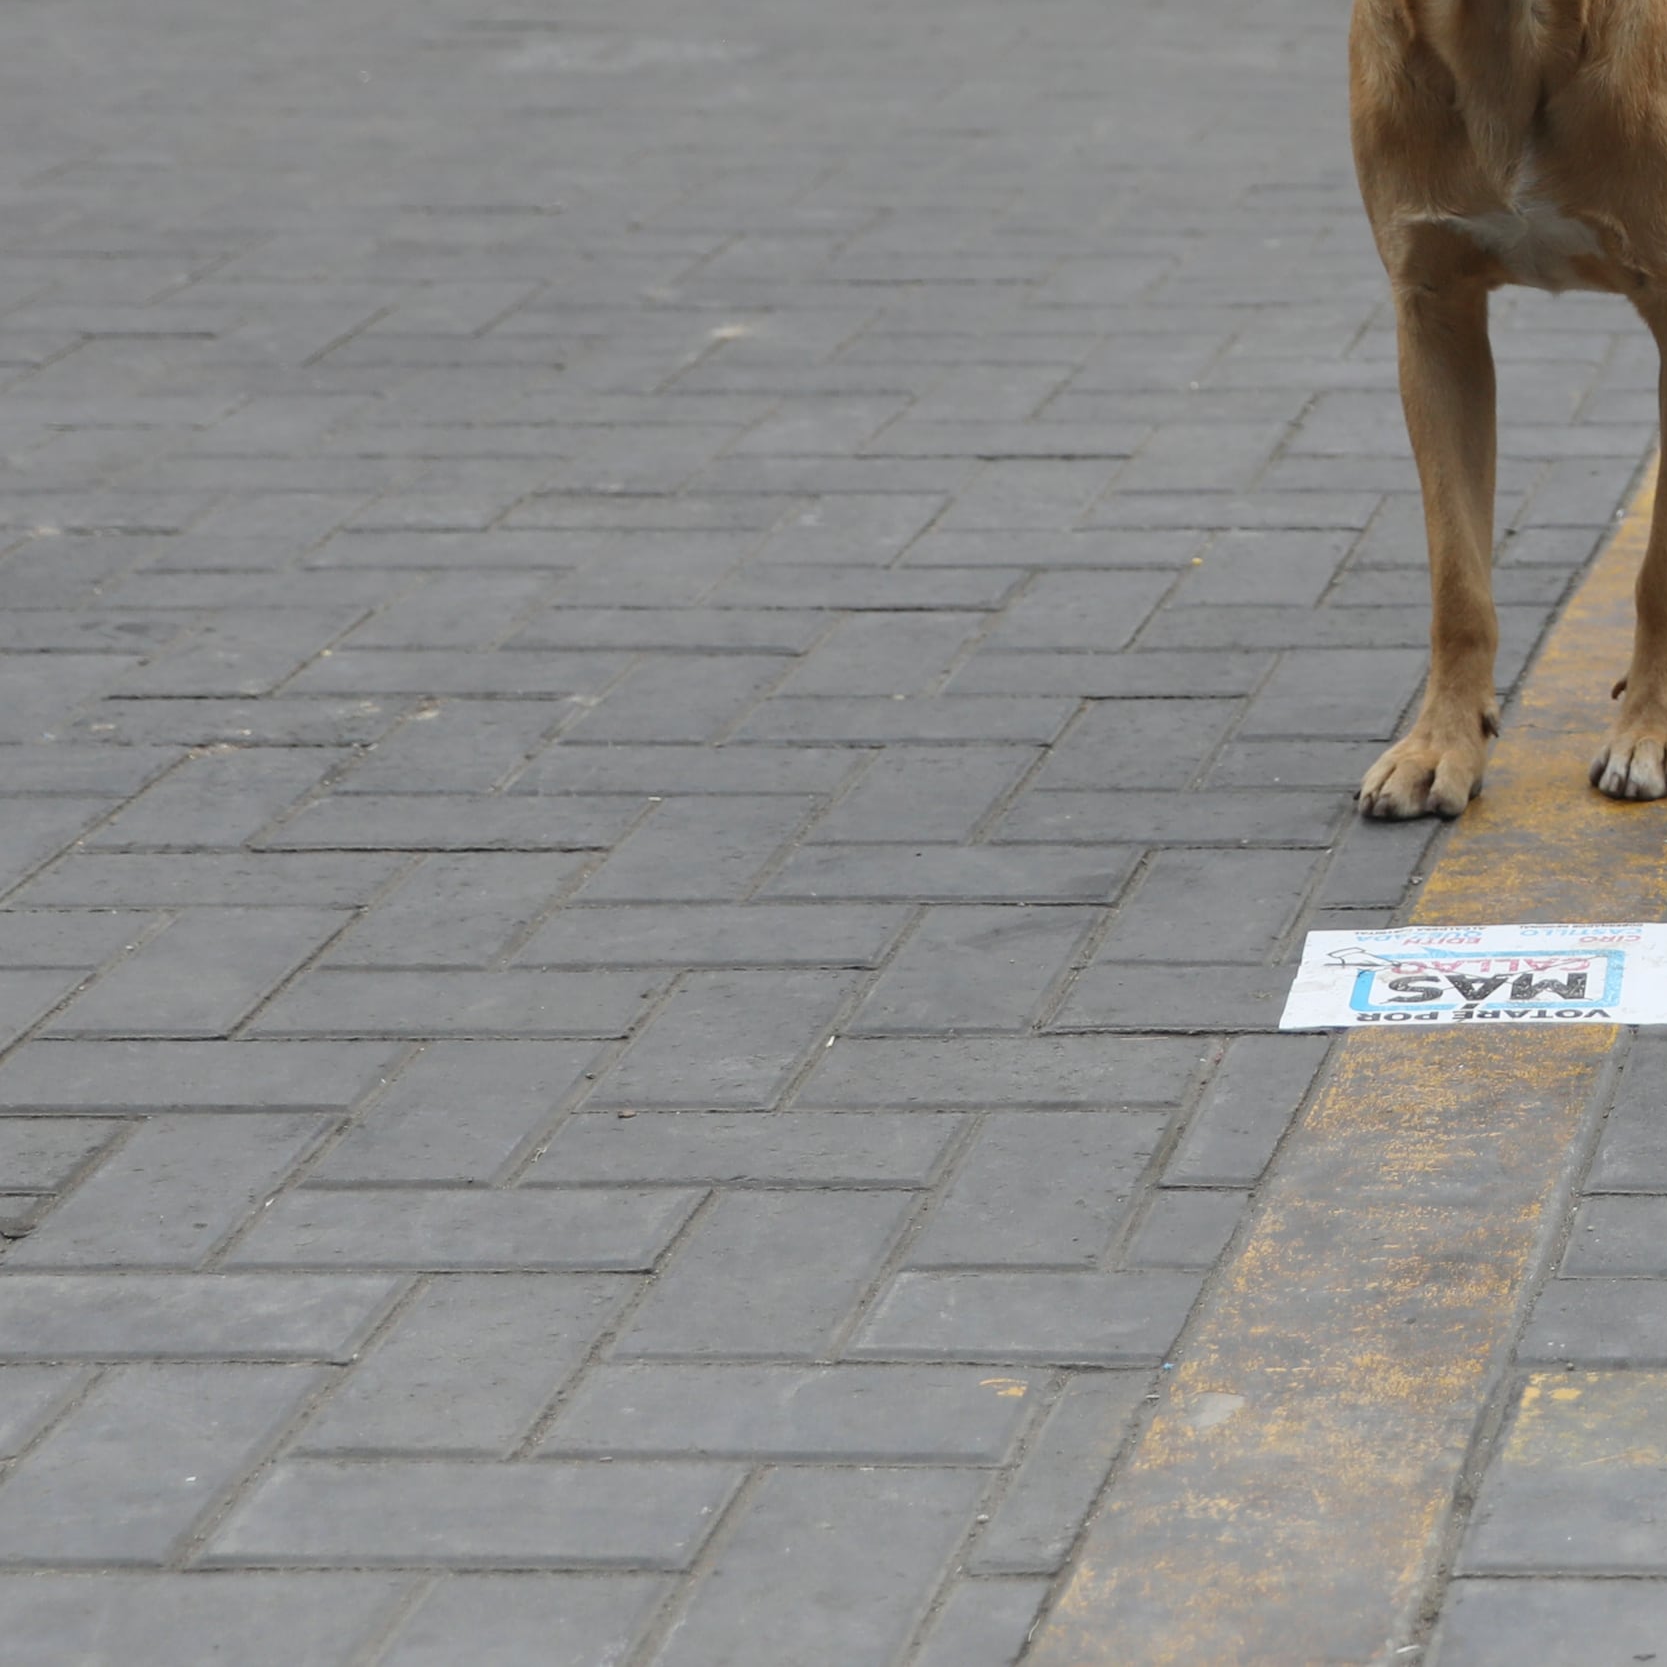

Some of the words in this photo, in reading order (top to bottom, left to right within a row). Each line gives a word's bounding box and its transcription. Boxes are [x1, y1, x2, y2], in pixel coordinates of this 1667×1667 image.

[1403, 937, 1482, 945] EDITH
[1579, 935, 1641, 943] CIRO
[1391, 958, 1590, 974] CALLAO
[1388, 972, 1588, 1010] MÁS
[1357, 1011, 1439, 1022] POR
